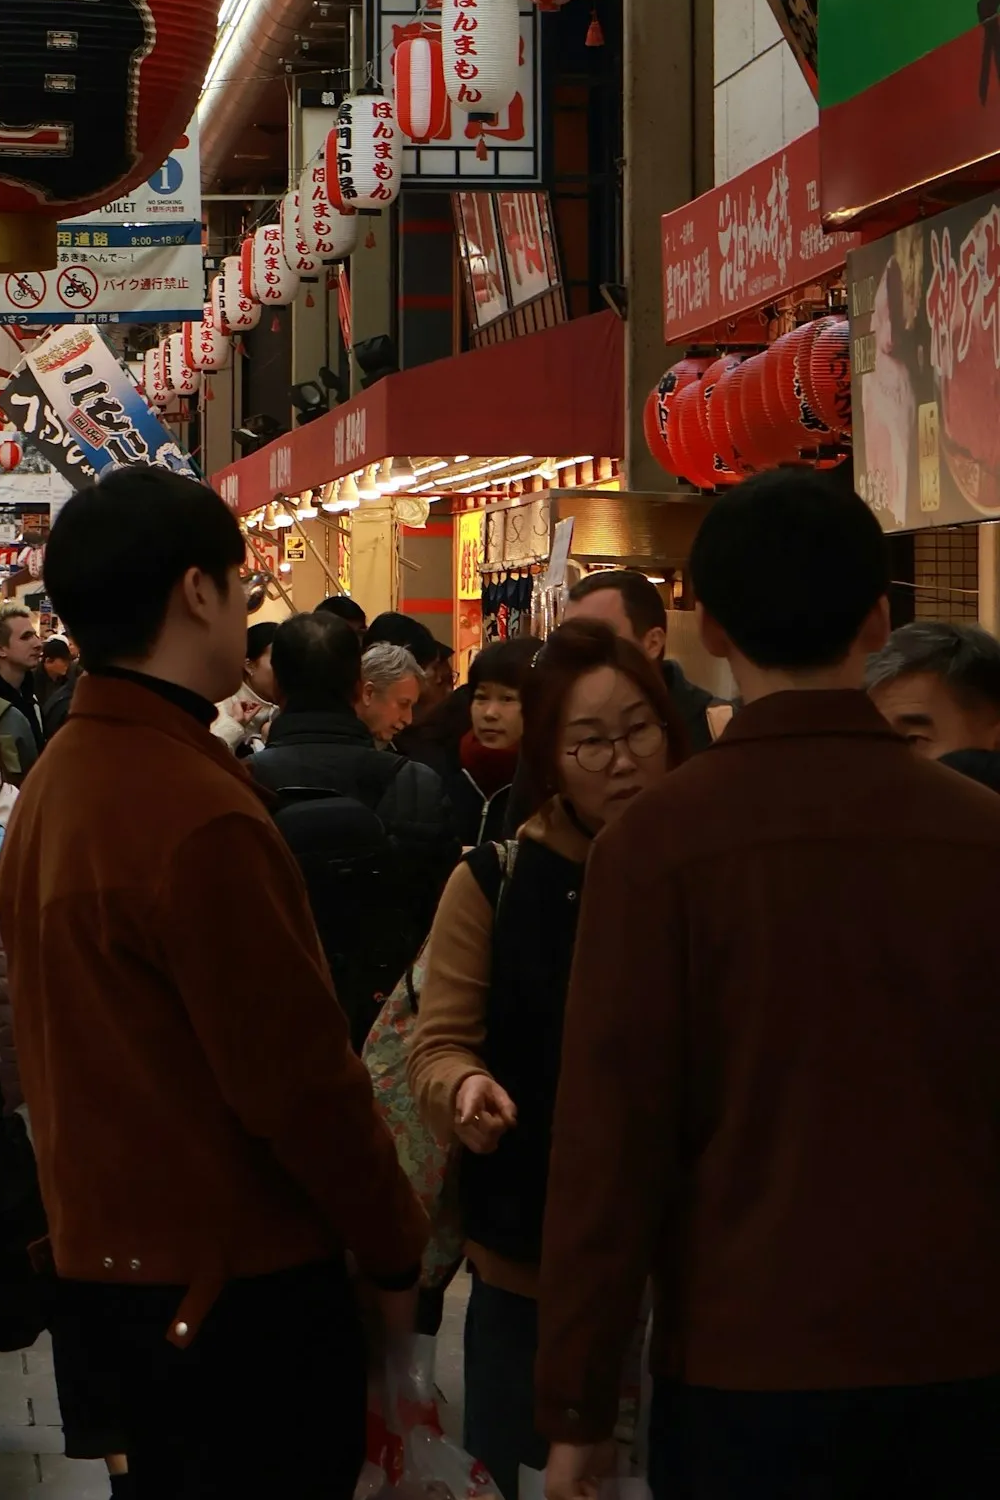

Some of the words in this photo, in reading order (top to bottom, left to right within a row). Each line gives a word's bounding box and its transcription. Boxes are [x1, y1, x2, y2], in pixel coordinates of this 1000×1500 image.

[369, 102, 394, 200] ほんまもん
[312, 167, 334, 253] ほんまもん
[104, 277, 189, 290] バイク通行禁止
[263, 229, 282, 299] ほんまもん
